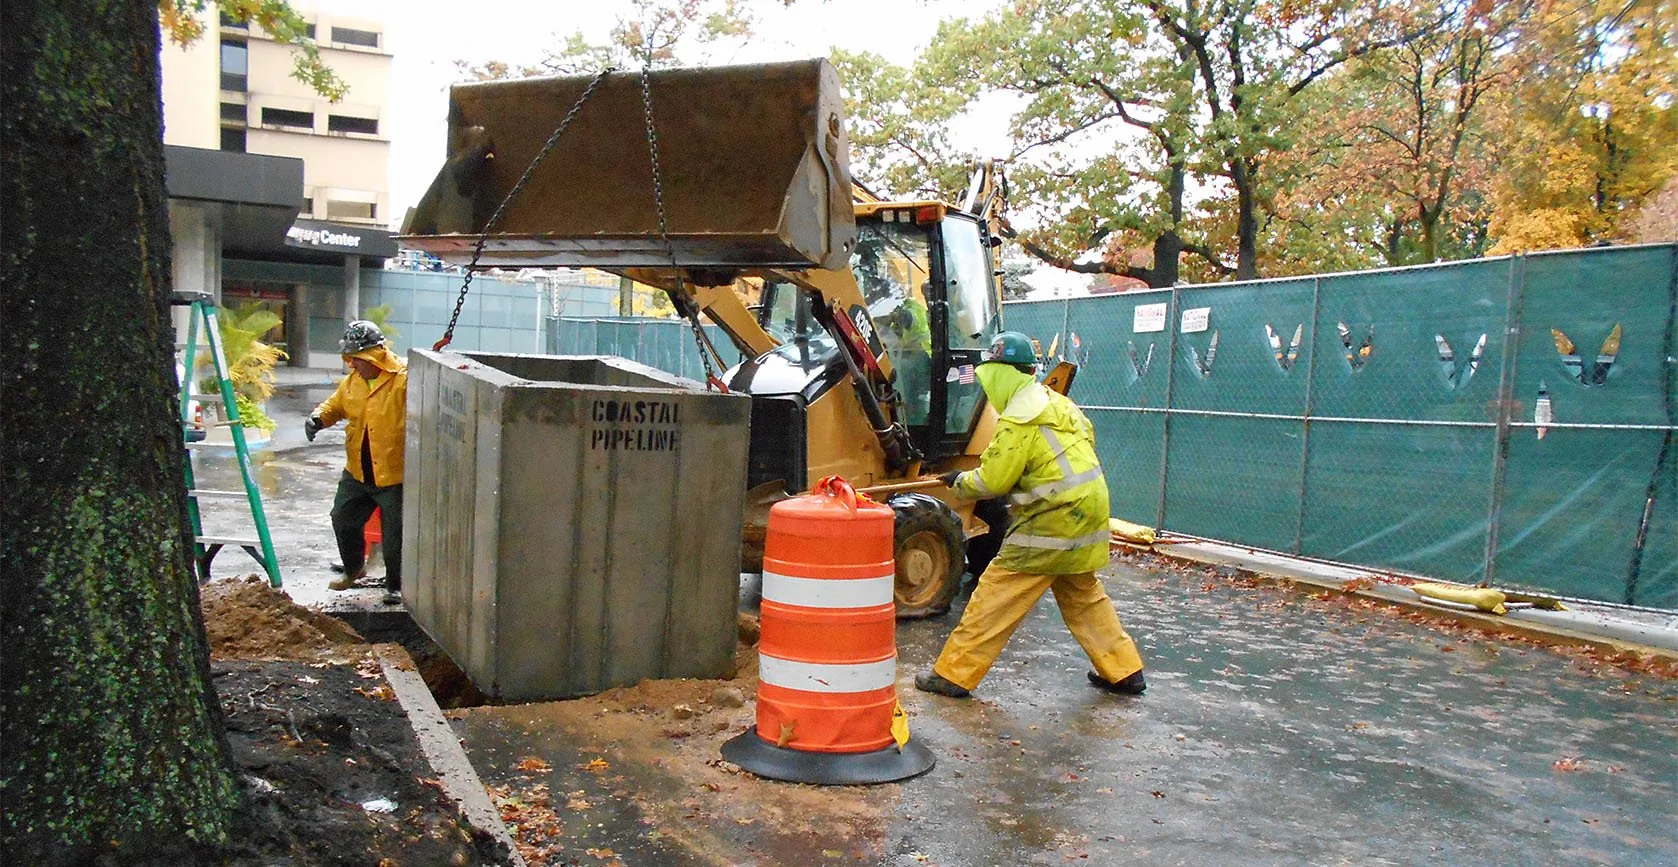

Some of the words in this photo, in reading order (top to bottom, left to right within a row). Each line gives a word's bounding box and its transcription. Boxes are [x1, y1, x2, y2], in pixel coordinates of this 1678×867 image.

[320, 230, 360, 247] Center
[855, 310, 872, 344] 420E
[592, 400, 679, 424] COASTAL
[592, 429, 677, 451] PIPELINE
